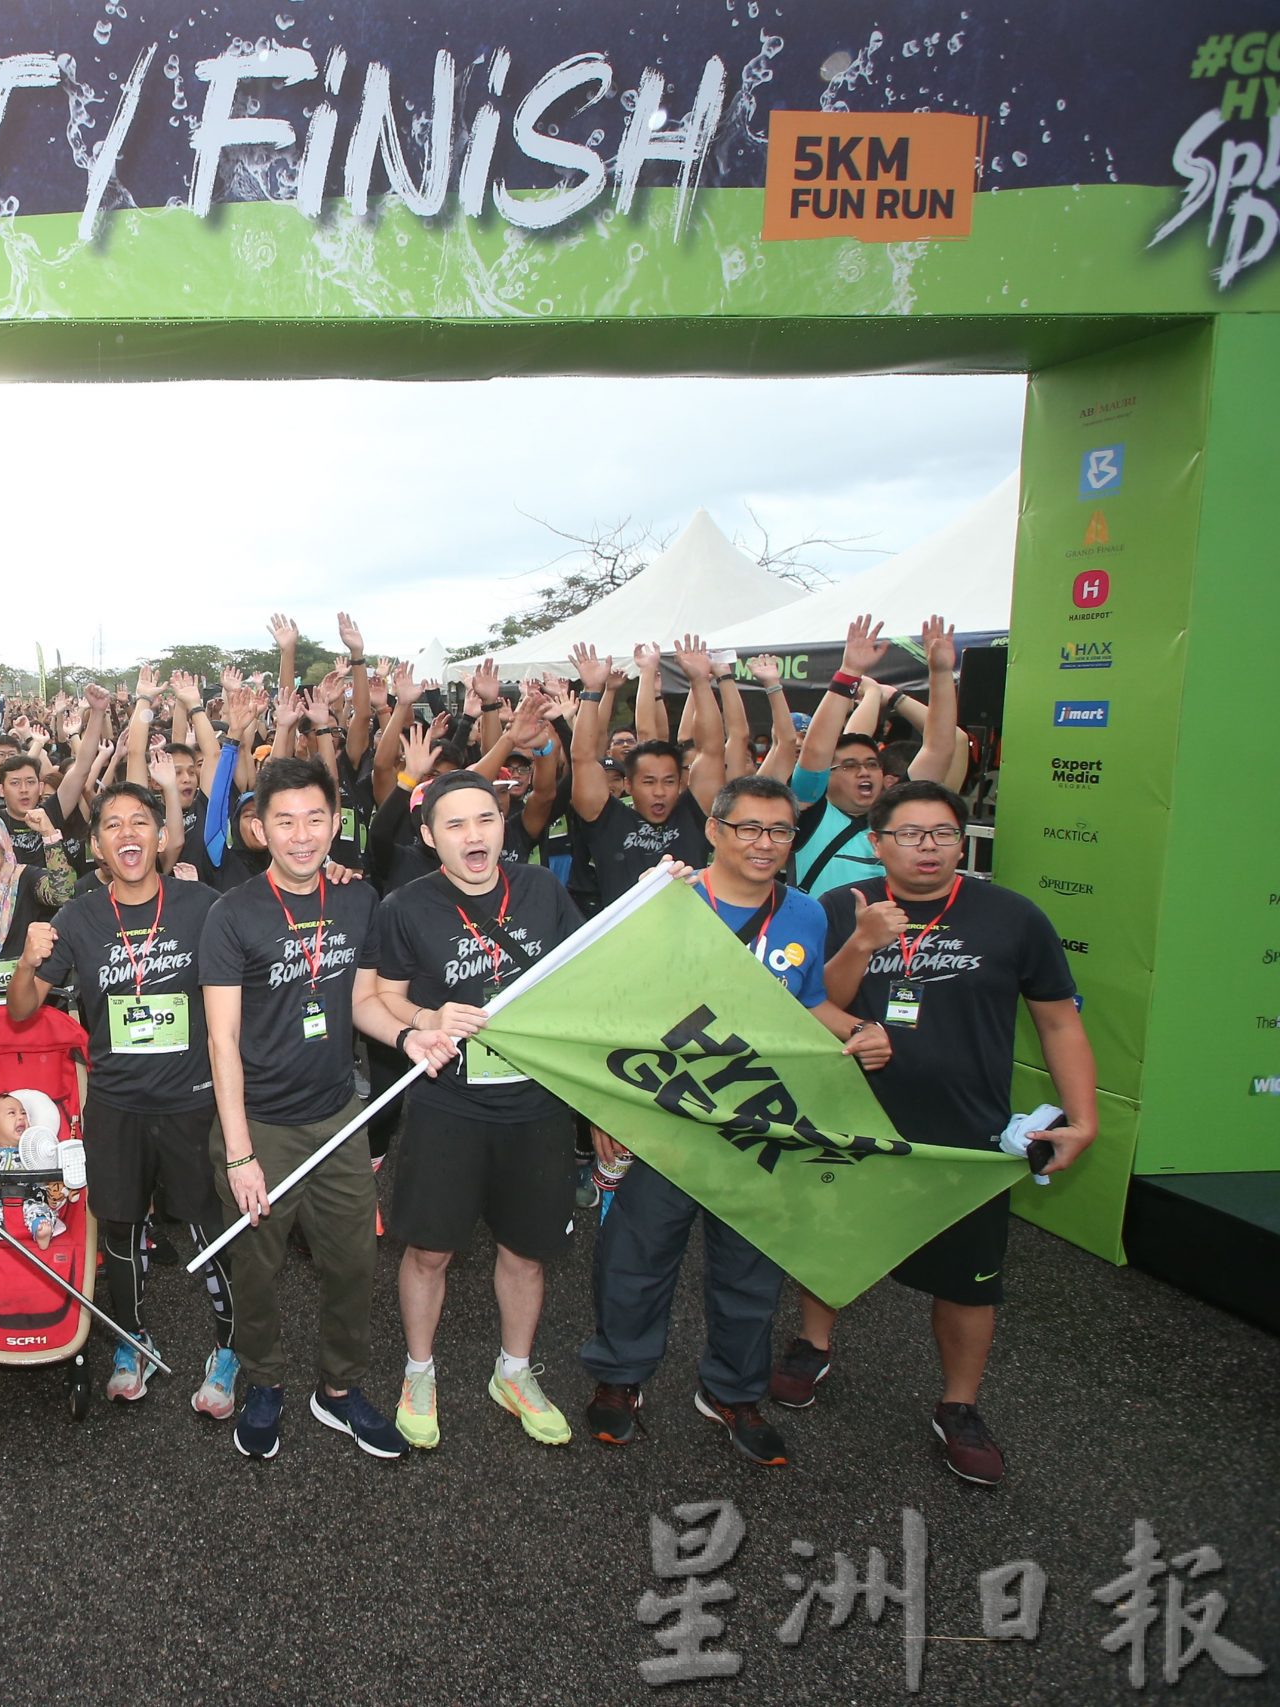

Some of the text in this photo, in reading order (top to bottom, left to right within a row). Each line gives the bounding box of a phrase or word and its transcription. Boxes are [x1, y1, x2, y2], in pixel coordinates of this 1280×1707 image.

[794, 136, 910, 182] 5KM
[790, 188, 953, 220] FUN RUN
[734, 655, 808, 680] MDIC
[1052, 770, 1099, 784] Media
[1044, 827, 1098, 843] PACKTICA
[158, 939, 179, 954] THE
[328, 933, 347, 948] THE
[937, 938, 965, 951] THE
